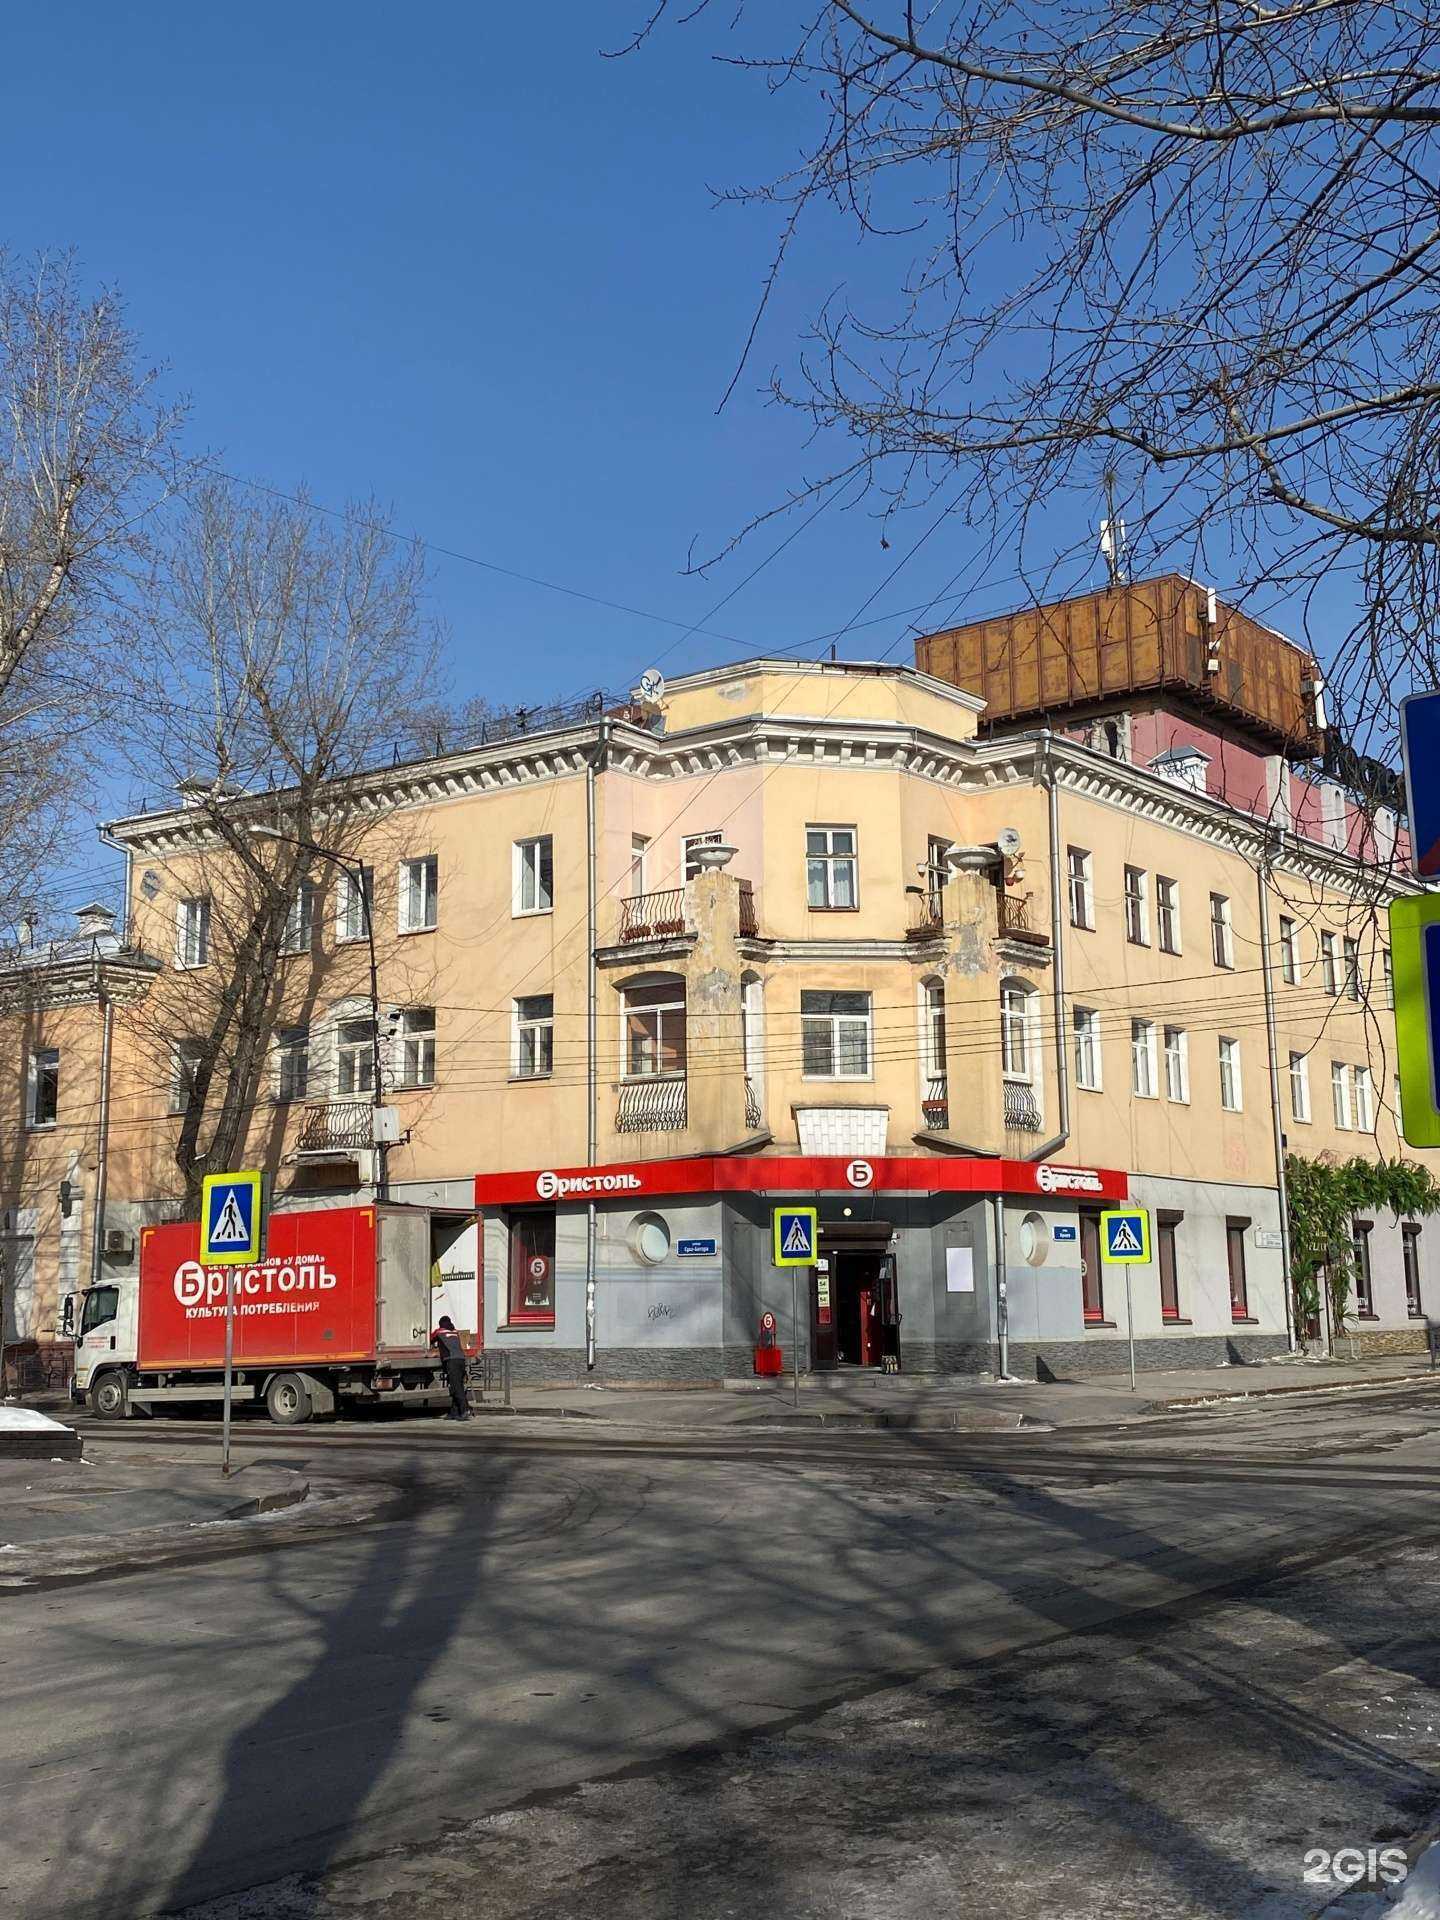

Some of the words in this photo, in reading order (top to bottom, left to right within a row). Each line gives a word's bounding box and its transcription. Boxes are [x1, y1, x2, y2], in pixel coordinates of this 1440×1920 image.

[537, 1172, 641, 1198] Бристоль
[851, 1162, 870, 1184] Б
[173, 1261, 336, 1306] Бристоль
[240, 1302, 320, 1316] ПОТРЕБЛЕНИЯ
